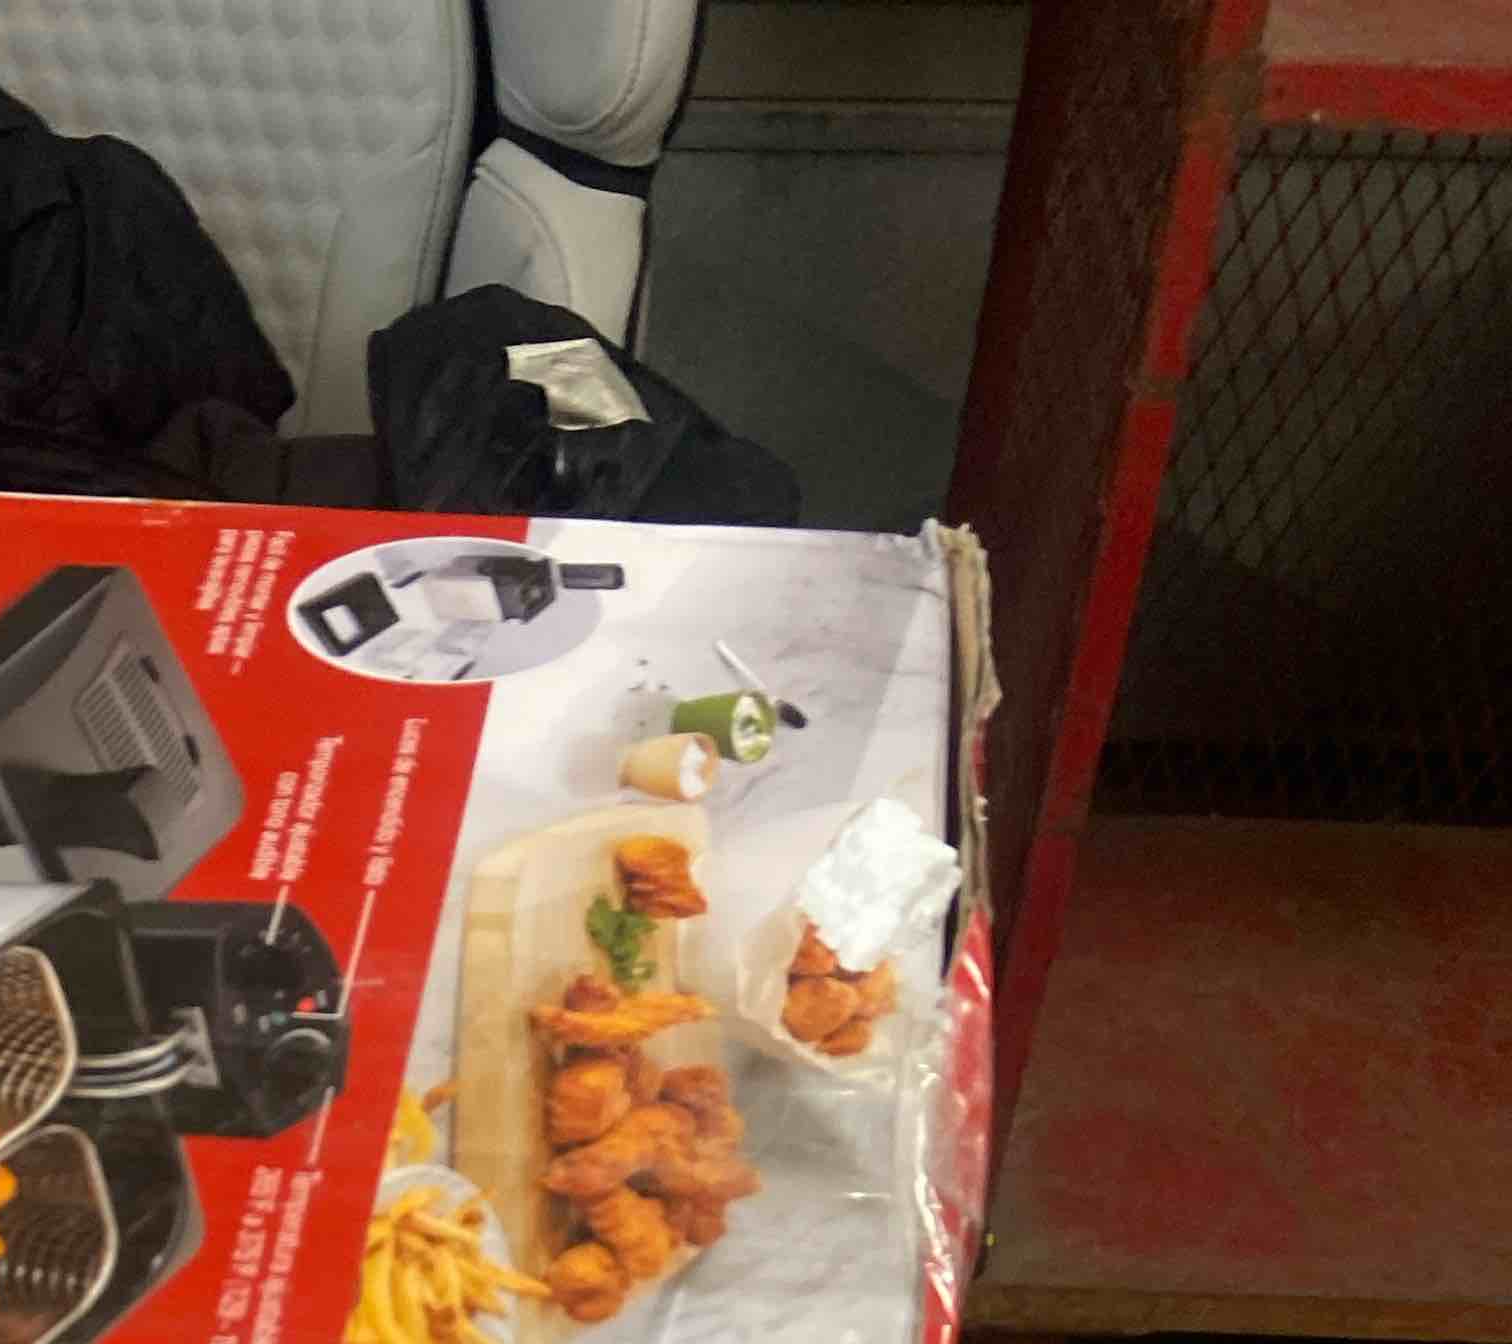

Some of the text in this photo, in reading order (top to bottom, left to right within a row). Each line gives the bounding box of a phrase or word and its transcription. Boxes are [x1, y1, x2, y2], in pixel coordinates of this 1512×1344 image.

[263, 796, 293, 830] tono
[249, 829, 280, 880] audible
[278, 821, 312, 881] ajustable
